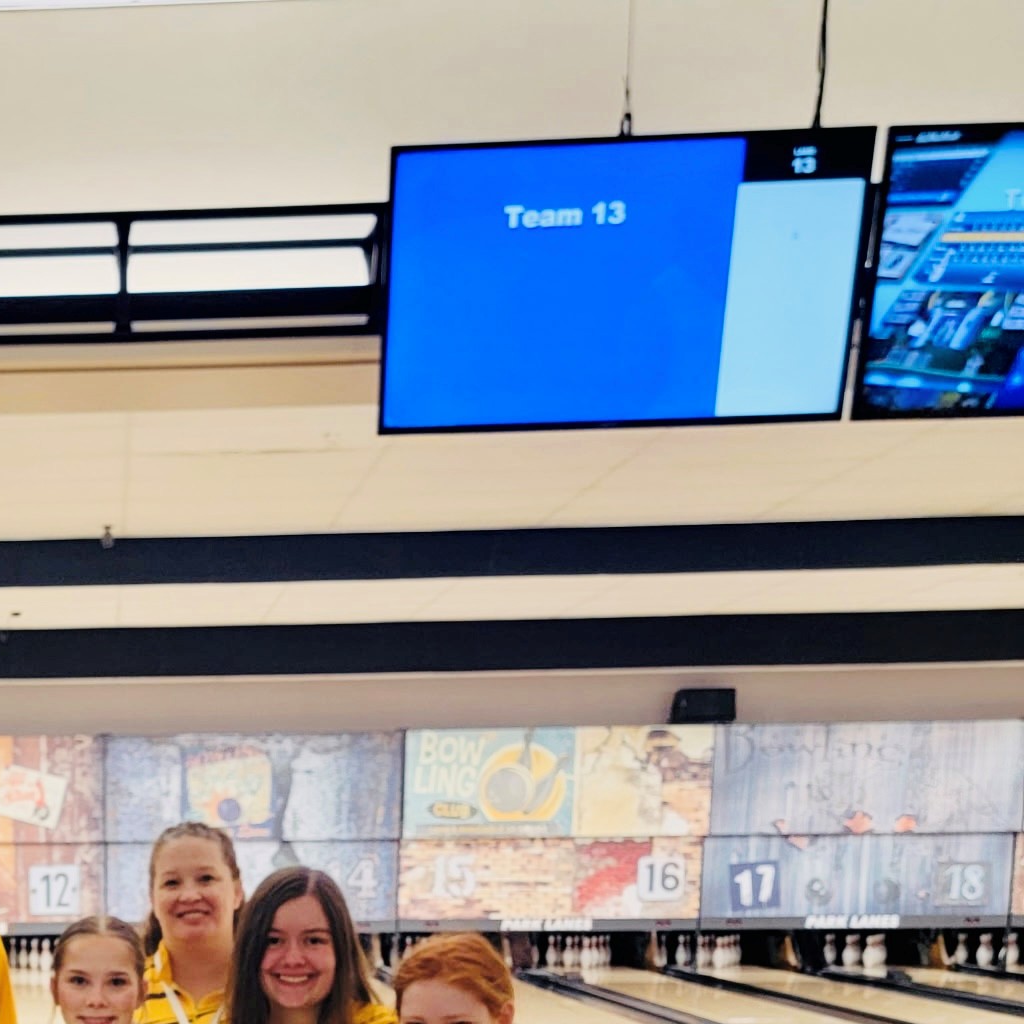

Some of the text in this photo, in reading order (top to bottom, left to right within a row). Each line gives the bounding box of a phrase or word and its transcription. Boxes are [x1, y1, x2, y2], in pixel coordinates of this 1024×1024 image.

[792, 157, 817, 174] 13
[504, 200, 626, 229] Team 13
[419, 729, 486, 766] BOW
[413, 764, 477, 798] LING
[41, 873, 71, 908] 12
[432, 854, 477, 899] 15
[645, 862, 680, 892] 16
[734, 863, 776, 907] 17
[945, 864, 985, 901] 18
[499, 918, 593, 932] PARK LANES
[804, 914, 901, 929] PARK LANES
